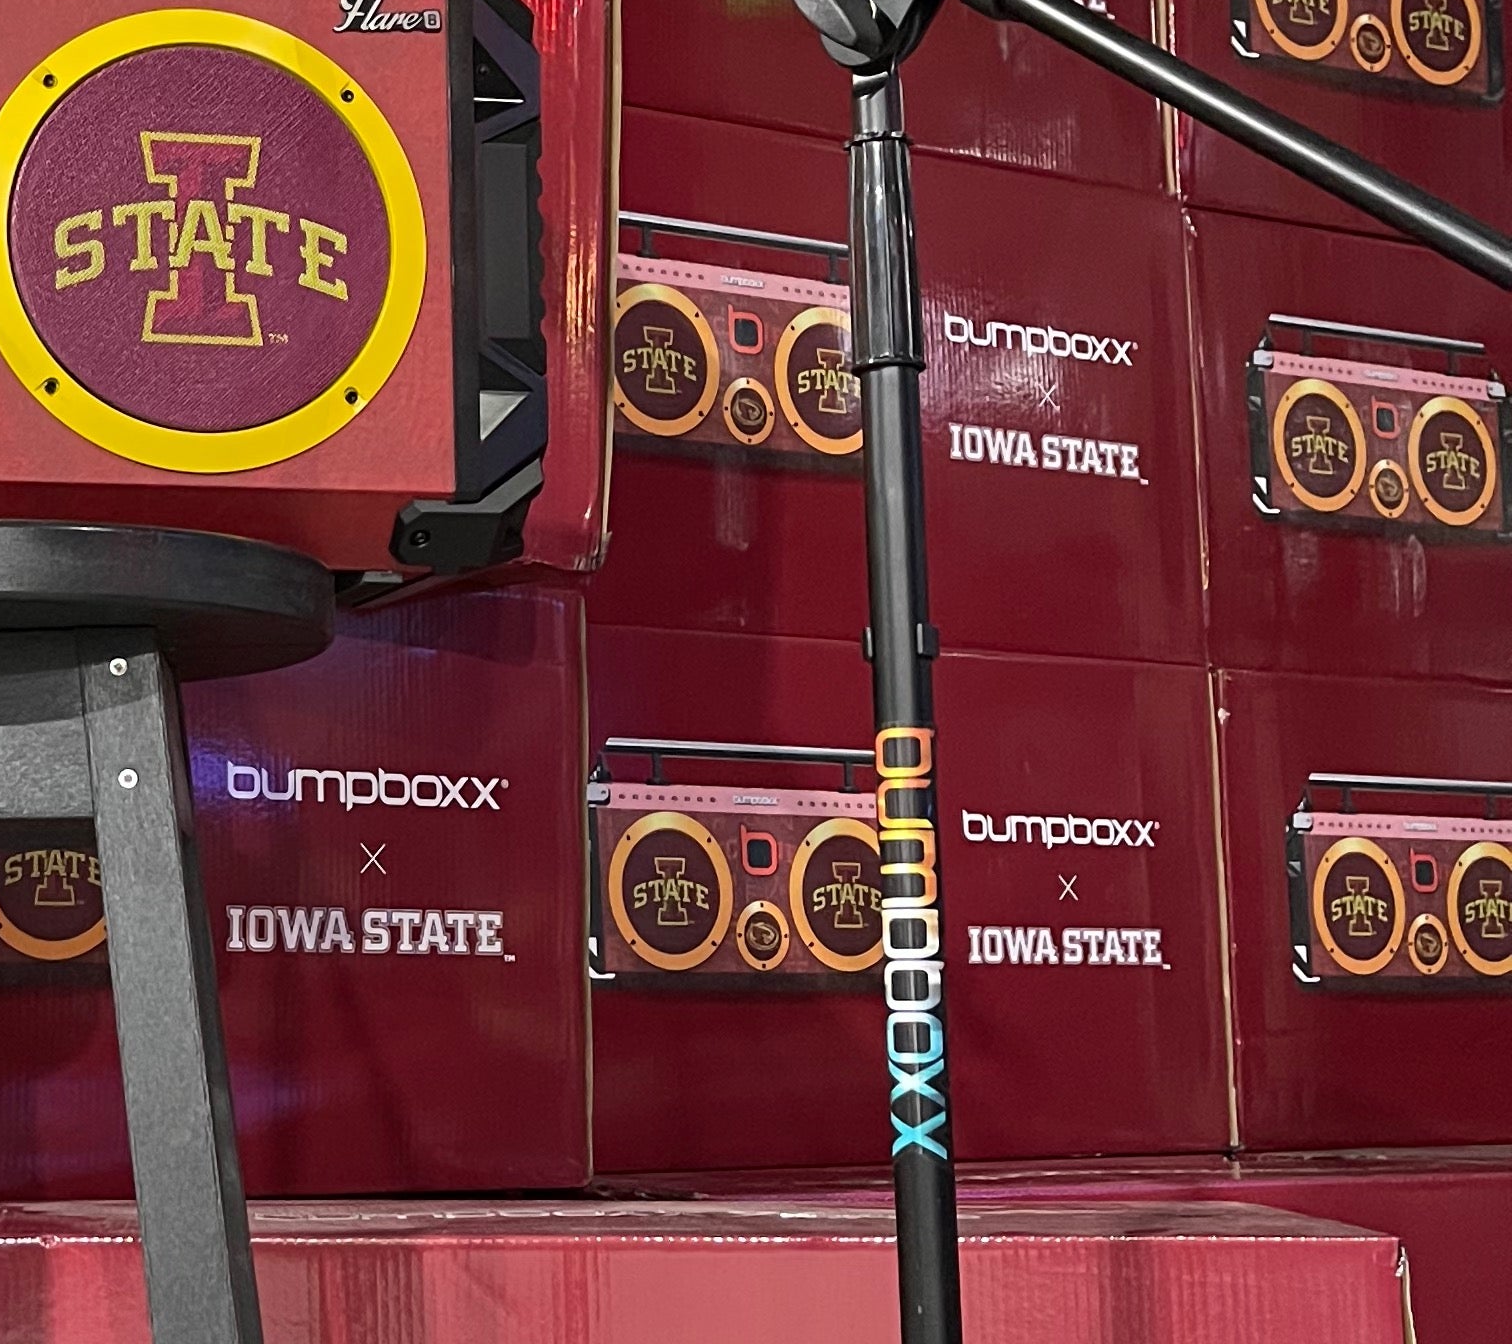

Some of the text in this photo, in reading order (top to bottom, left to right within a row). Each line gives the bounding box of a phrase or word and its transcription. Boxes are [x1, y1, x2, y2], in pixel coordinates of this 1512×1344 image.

[1409, 10, 1465, 41] STATE
[54, 202, 349, 301] STATE
[944, 310, 1133, 366] bumpboxx
[623, 346, 697, 382] STATE
[949, 423, 1140, 479] IOWA STATE
[1291, 434, 1349, 463] STATE
[1426, 451, 1481, 479] STATE
[227, 761, 504, 811] bumpboxx
[961, 809, 1157, 850] bumpboxx
[633, 878, 710, 910] STATE
[1331, 894, 1389, 923] STATE
[227, 906, 504, 956] IOWA STATE
[874, 726, 948, 1160] bumpboxx
[968, 926, 1163, 966] IOWA STATE
